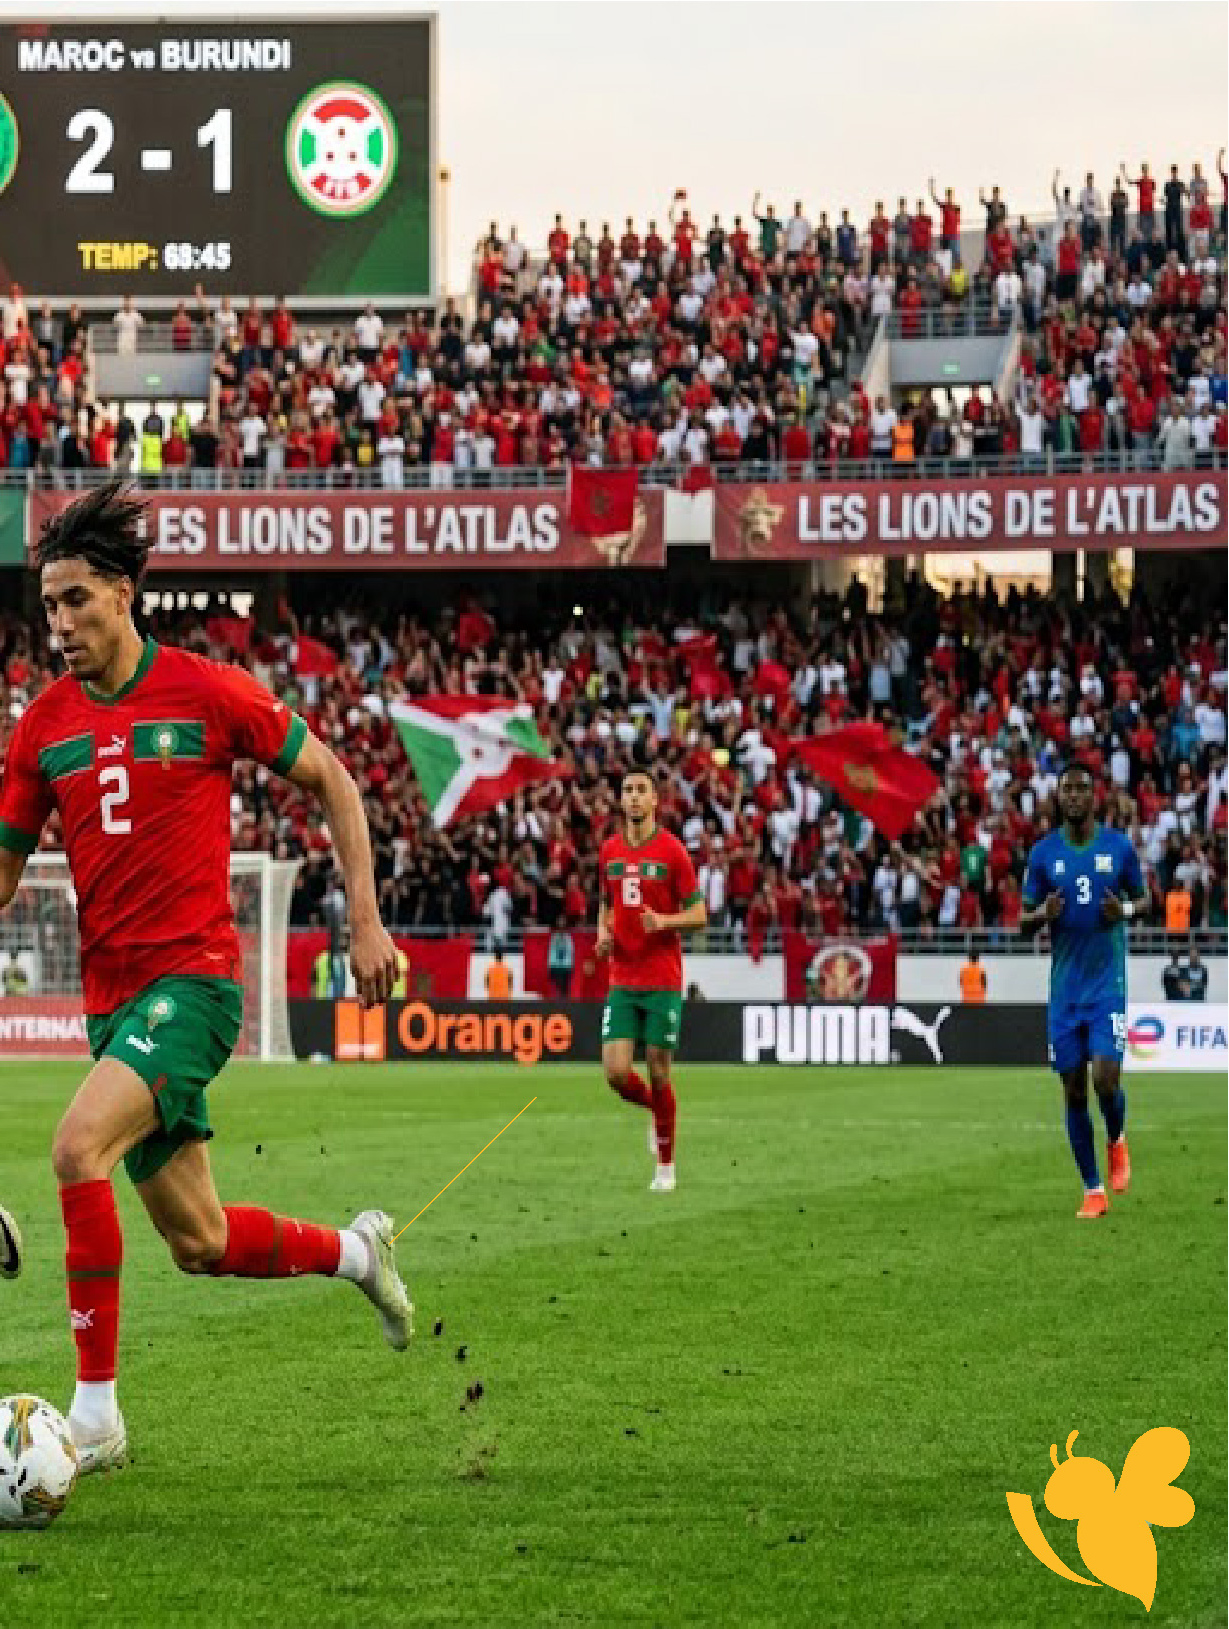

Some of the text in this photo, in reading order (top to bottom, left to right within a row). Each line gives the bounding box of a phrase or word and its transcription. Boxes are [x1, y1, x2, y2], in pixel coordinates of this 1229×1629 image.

[18, 39, 125, 71] MAROC
[161, 39, 292, 71] BURUNDI
[65, 108, 115, 193] 2
[140, 149, 173, 171] -
[197, 108, 233, 193] 1
[77, 242, 159, 271] TEMP:
[136, 502, 562, 556] ES LIONS DE L'ATLAS
[797, 482, 1221, 543] LES LIONS DE L'ATLAS
[99, 764, 132, 835] 2
[621, 877, 642, 907] 6
[1076, 875, 1093, 905] 3
[398, 1000, 573, 1064] Orange
[742, 1005, 891, 1065] PUMA
[1177, 1024, 1228, 1050] FIFA
